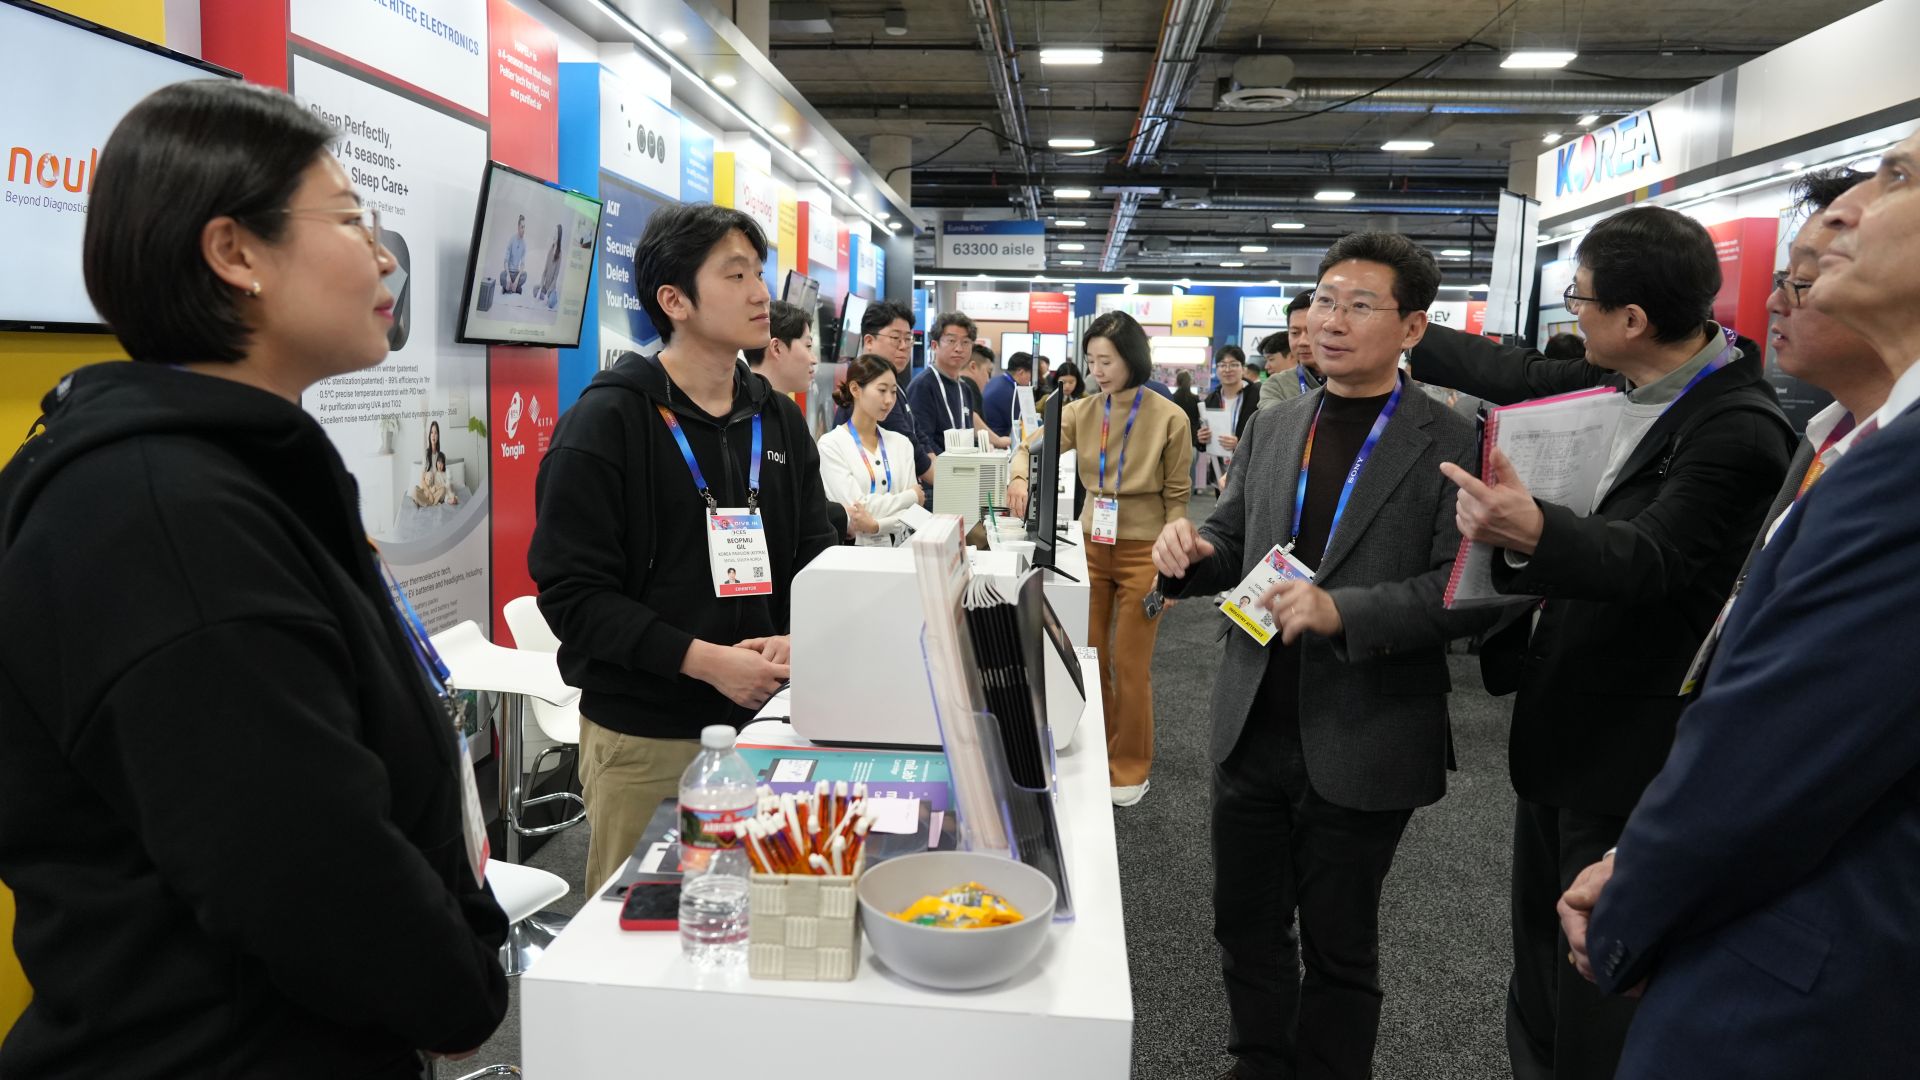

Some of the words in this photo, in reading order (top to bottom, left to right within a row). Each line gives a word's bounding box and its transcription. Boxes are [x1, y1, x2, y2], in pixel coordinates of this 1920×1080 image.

[420, 11, 480, 56] ELECTRONICS
[345, 114, 392, 149] Perfectly,
[345, 141, 352, 158] 4
[355, 147, 395, 170] seasons
[1556, 110, 1661, 196] KOREA
[8, 147, 98, 194] noul
[351, 166, 379, 193] Sleep
[381, 175, 409, 196] Care+
[6, 191, 41, 207] Beyond
[606, 236, 637, 263] Securely
[953, 243, 999, 256] 63300
[1001, 242, 1036, 256] aisle
[606, 263, 630, 283] Delete
[606, 290, 623, 309] Your
[335, 389, 354, 399] precise
[354, 388, 383, 399] temperature
[320, 403, 328, 411] Air
[328, 402, 358, 412] purification
[501, 441, 525, 460] Yongin
[767, 450, 786, 465] noul
[1348, 457, 1363, 484] SONY
